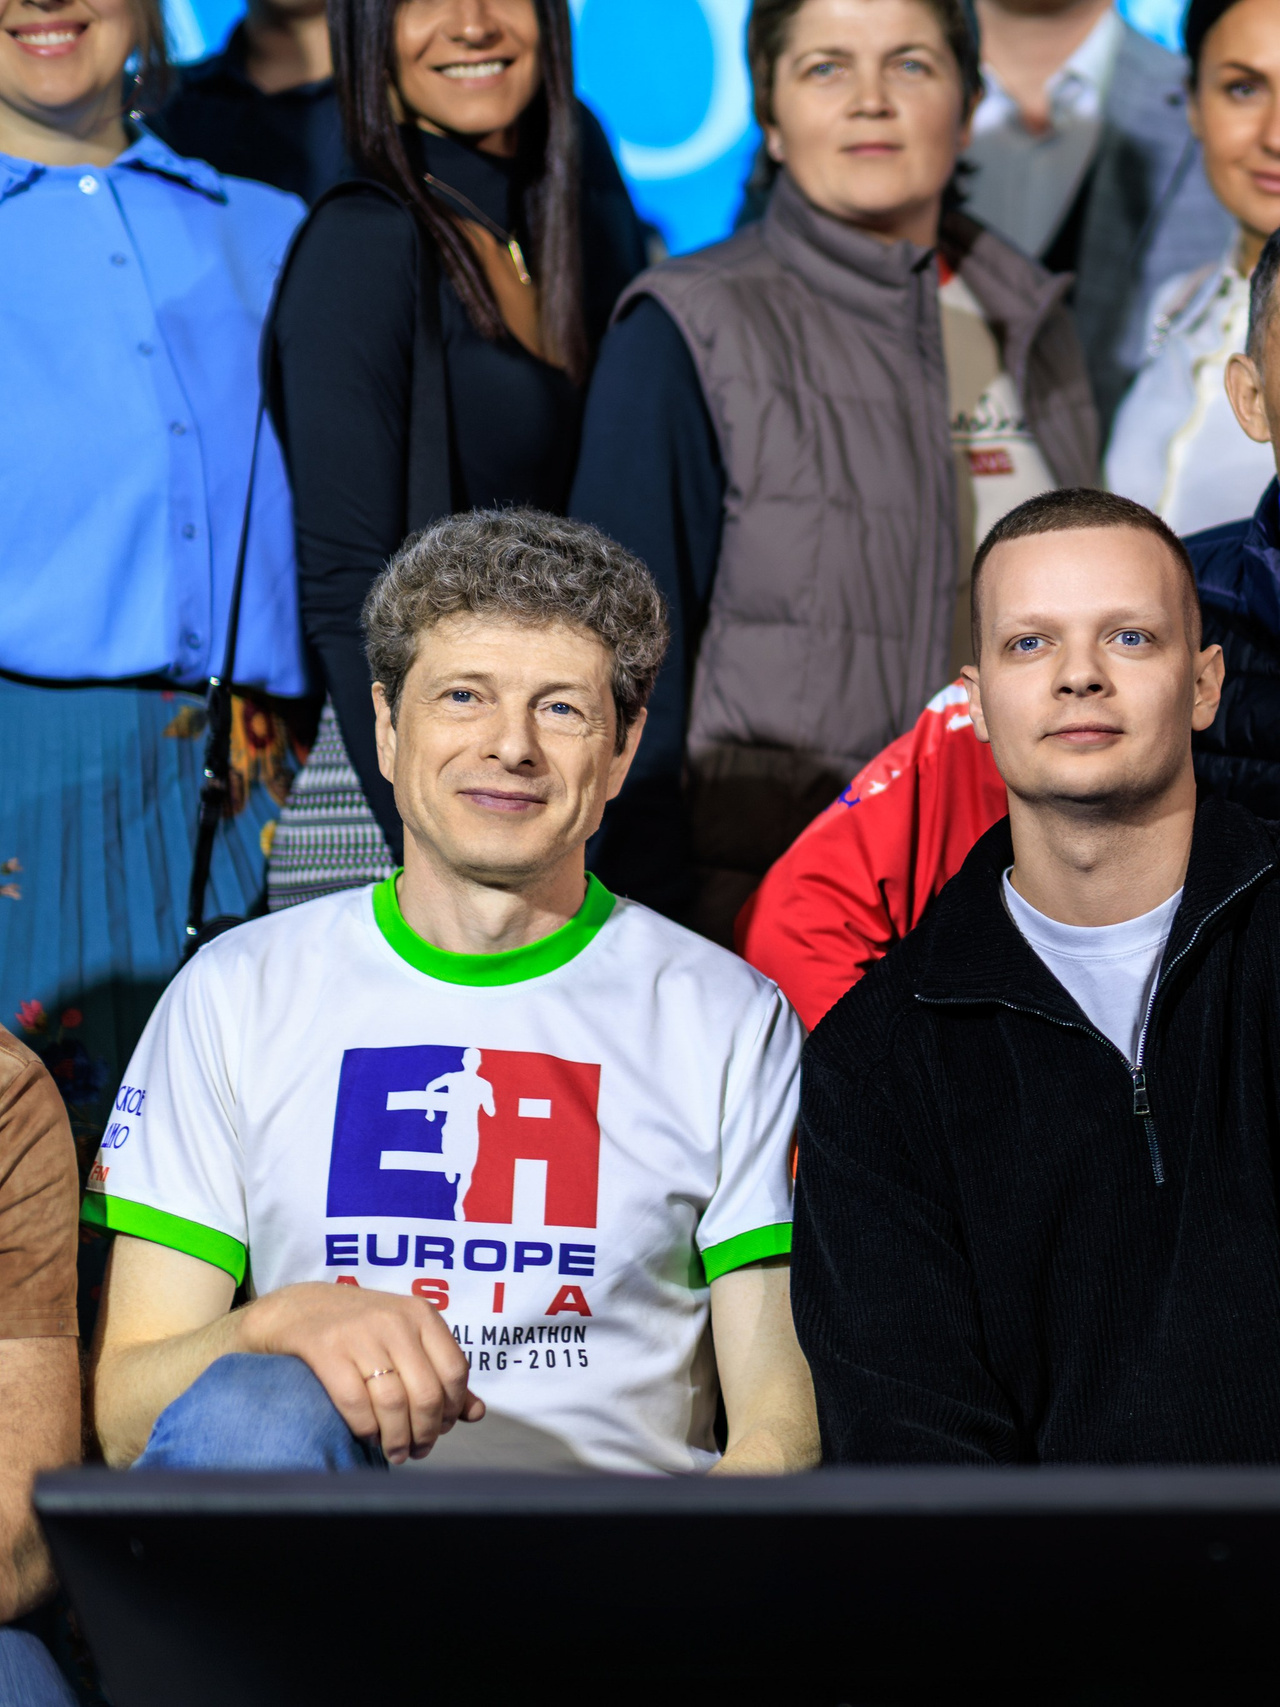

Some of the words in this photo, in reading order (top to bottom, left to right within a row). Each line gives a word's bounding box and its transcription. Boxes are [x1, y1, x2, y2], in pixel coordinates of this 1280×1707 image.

[325, 1233, 596, 1277] EUROPE
[452, 1324, 474, 1345] AL
[481, 1325, 586, 1345] MARATHON
[463, 1349, 588, 1371] URG-2015
